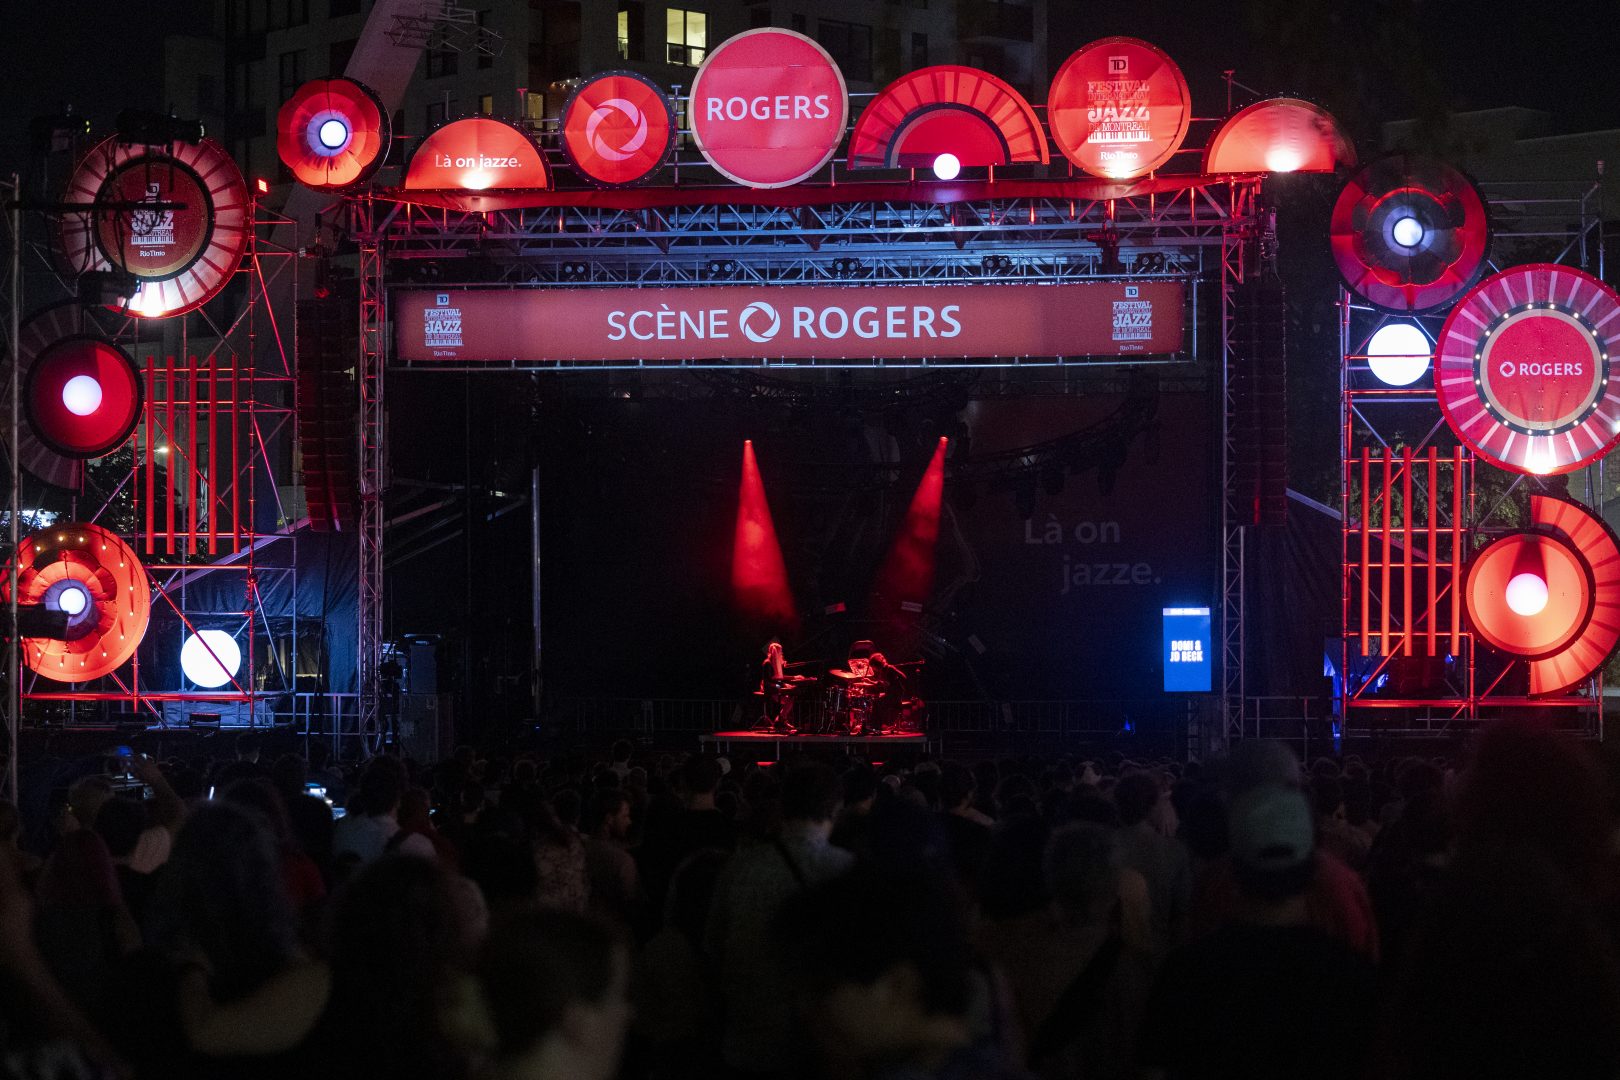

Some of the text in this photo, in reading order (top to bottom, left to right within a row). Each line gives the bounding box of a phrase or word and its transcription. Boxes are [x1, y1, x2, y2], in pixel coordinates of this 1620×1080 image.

[1110, 58, 1128, 72] TD
[1087, 81, 1150, 92] FESTIVAL
[706, 94, 831, 121] ROGERS
[1087, 100, 1150, 123] JAZZ
[435, 153, 522, 172] Là on jazze.
[424, 308, 462, 316] FESTIVAL
[1113, 301, 1152, 309] FESTIVAL
[425, 320, 462, 334] JAZZ
[607, 303, 962, 341] SCÈNE ROGERS
[1113, 313, 1152, 327] JAZZ
[1519, 362, 1583, 376] ROGERS
[1025, 513, 1121, 544] Là on
[1061, 554, 1162, 595] jazze.
[1171, 640, 1202, 651] DOMI &
[1170, 651, 1204, 662] JD BECK
